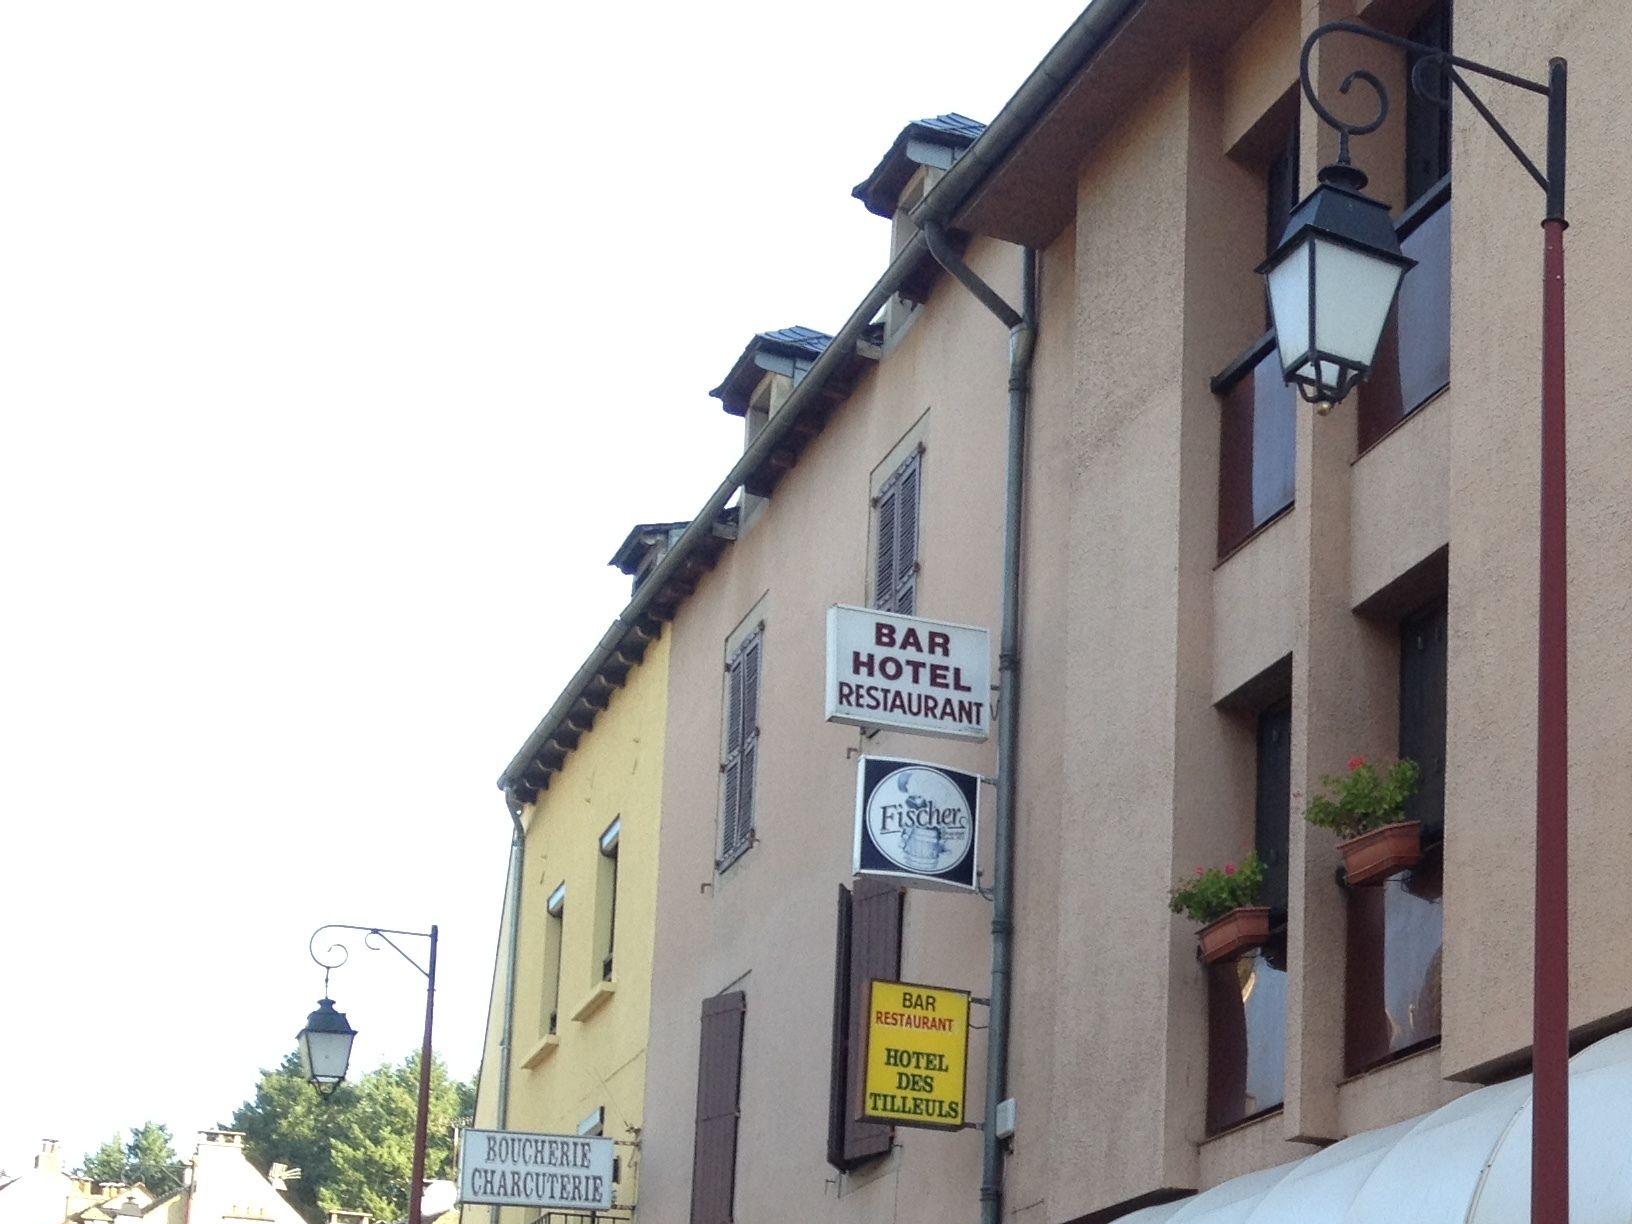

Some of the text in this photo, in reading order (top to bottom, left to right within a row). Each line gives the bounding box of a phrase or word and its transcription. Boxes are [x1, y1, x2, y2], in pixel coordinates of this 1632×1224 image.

[875, 622, 950, 658] BAR
[852, 650, 972, 693] HOTEL
[838, 680, 984, 726] RESTAURANT
[880, 800, 961, 831] Fischer
[902, 991, 937, 1013] BAR
[875, 1010, 955, 1033] RESTAURANT
[884, 1047, 949, 1073] HOTEL
[895, 1071, 934, 1094] DES
[869, 1092, 960, 1120] TILLEULS
[484, 1134, 592, 1169] BOUCHERIE
[470, 1167, 604, 1202] CHARCUTERIE
